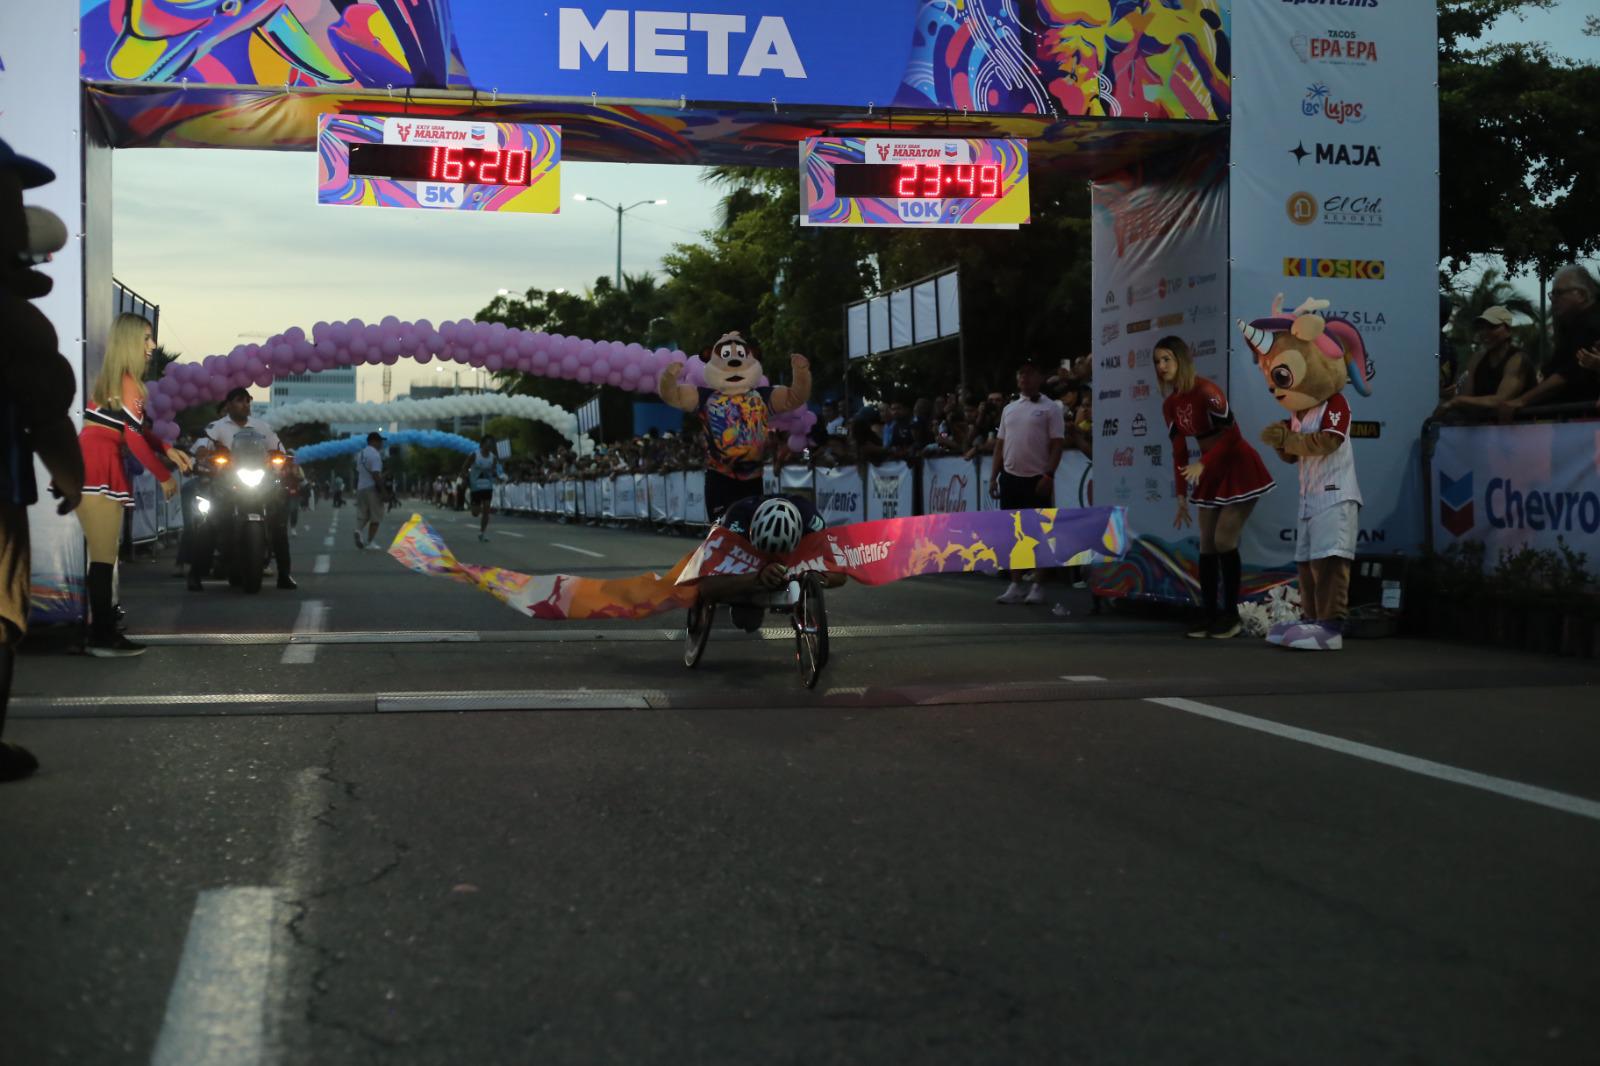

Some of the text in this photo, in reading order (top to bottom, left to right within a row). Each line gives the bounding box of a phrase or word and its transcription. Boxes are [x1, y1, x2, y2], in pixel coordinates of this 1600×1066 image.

[559, 7, 808, 79] META
[1328, 29, 1356, 39] TACOS
[1324, 96, 1364, 124] Lujos
[1315, 142, 1380, 167] MAJA
[424, 185, 456, 204] 5K
[1324, 195, 1382, 213] El Cid
[900, 200, 939, 218] 10K
[1284, 258, 1384, 279] KIOSKO
[1485, 477, 1600, 534] Chevro
